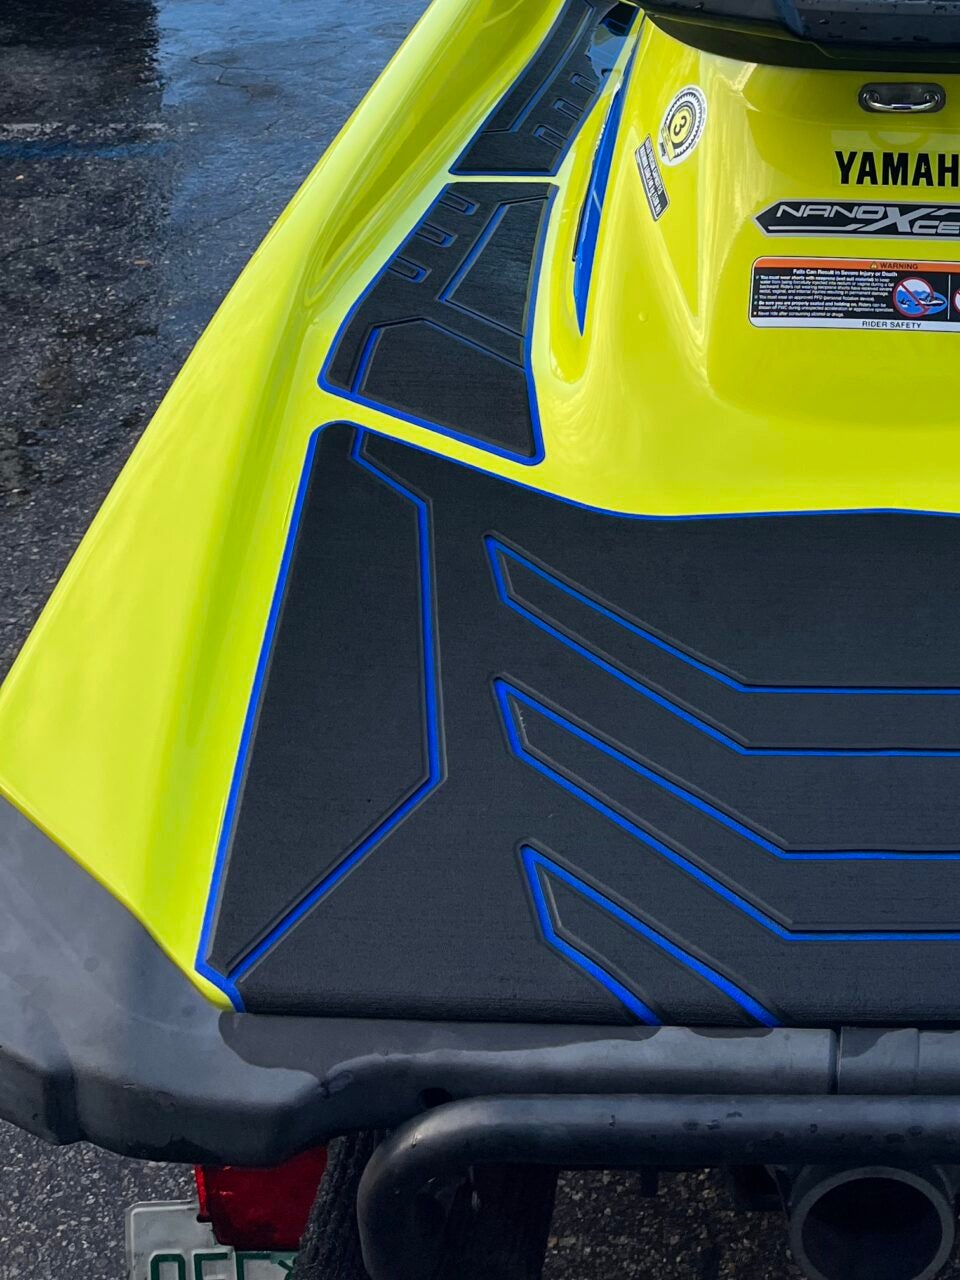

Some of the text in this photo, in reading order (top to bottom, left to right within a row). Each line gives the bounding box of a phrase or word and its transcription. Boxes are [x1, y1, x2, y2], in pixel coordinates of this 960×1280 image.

[880, 262, 919, 270] WARNING
[862, 320, 922, 330] RIDER SAFETY
